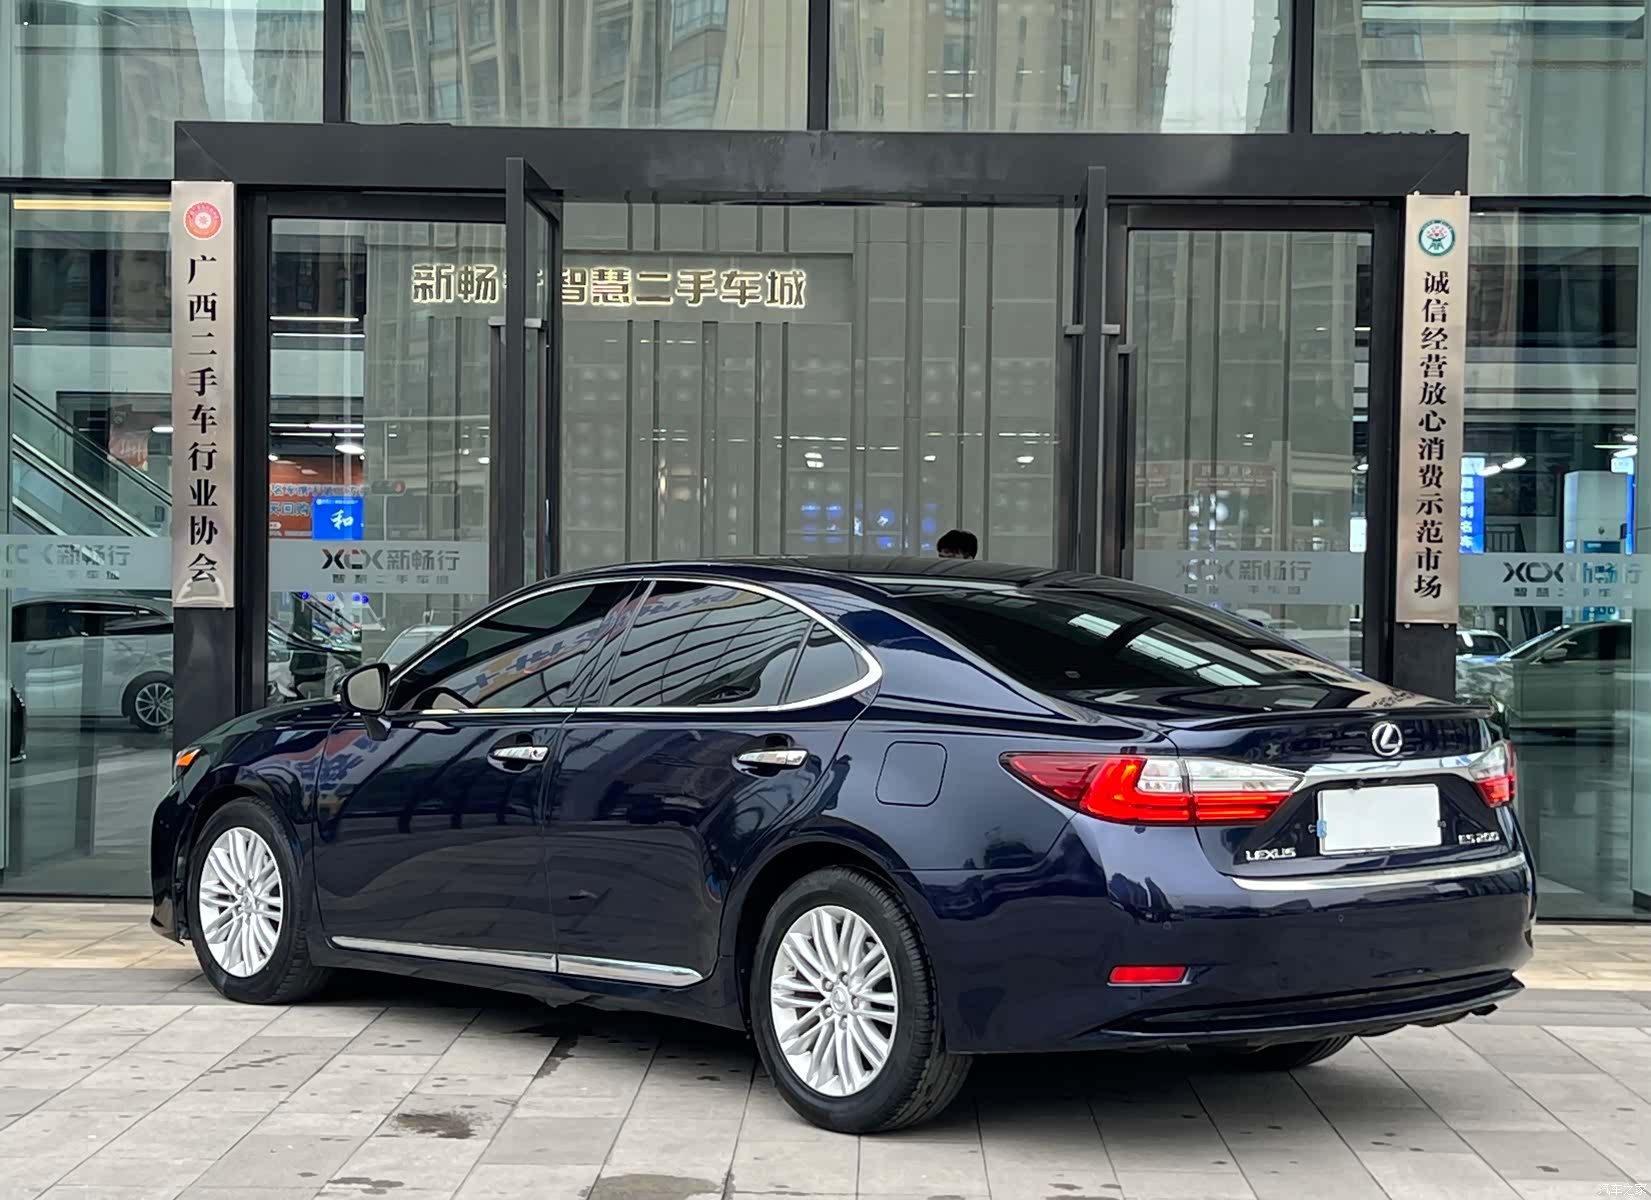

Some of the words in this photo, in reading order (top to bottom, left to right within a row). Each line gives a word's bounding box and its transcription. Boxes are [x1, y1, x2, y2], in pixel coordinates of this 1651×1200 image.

[411, 264, 806, 307] 新畅智慧二手车城
[187, 254, 218, 583] 广西二手车行业协会
[1413, 270, 1450, 599] 诚信经营放心消费示范市场
[330, 509, 354, 530] 和
[387, 549, 460, 571] 新畅行
[1245, 847, 1297, 861] LEXUS
